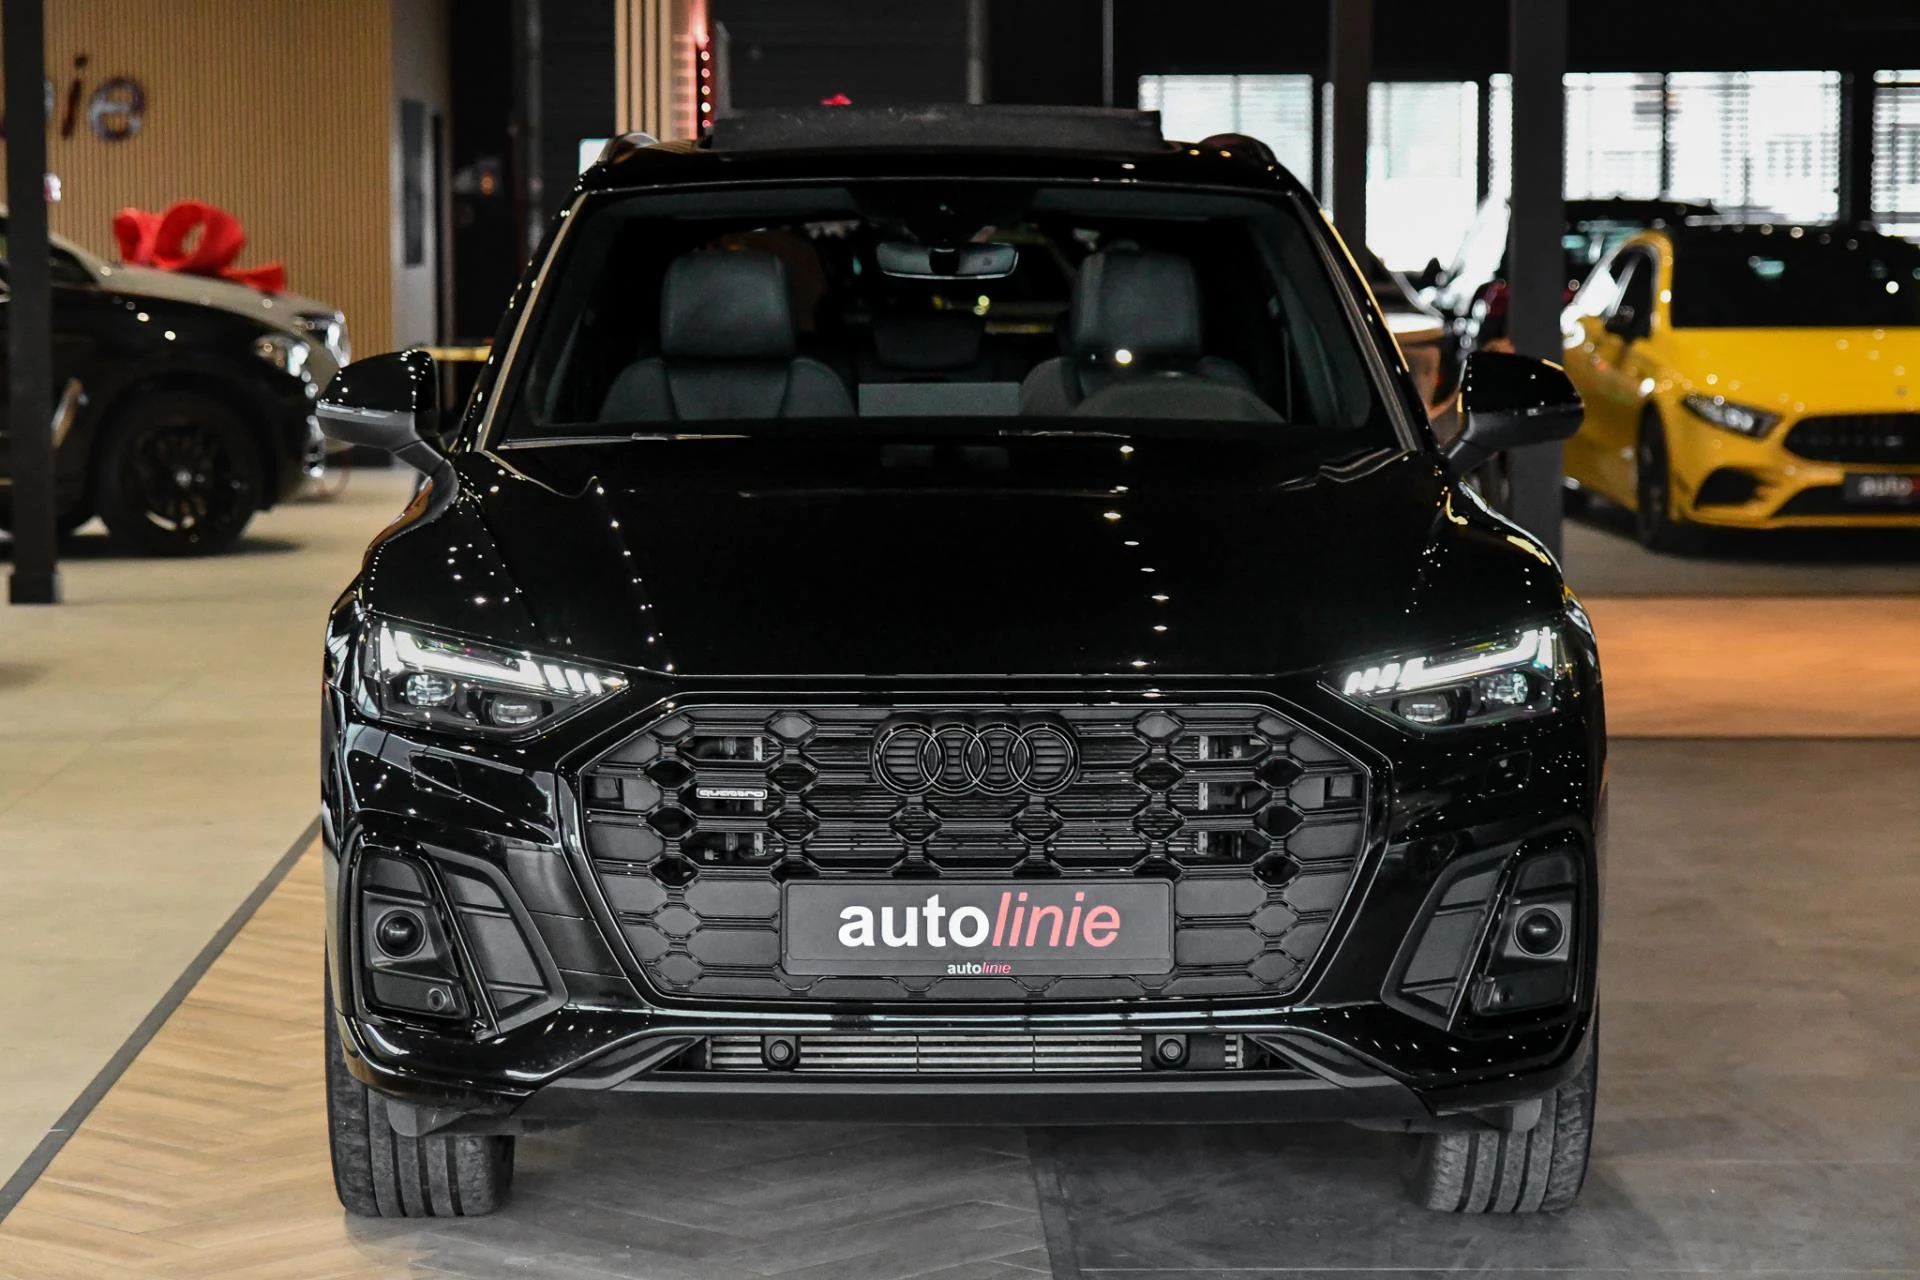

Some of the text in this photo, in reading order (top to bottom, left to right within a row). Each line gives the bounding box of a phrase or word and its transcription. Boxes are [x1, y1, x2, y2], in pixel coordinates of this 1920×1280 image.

[698, 788, 765, 798] quattro
[838, 891, 1121, 947] autolinie
[947, 961, 1012, 974] autolinie
